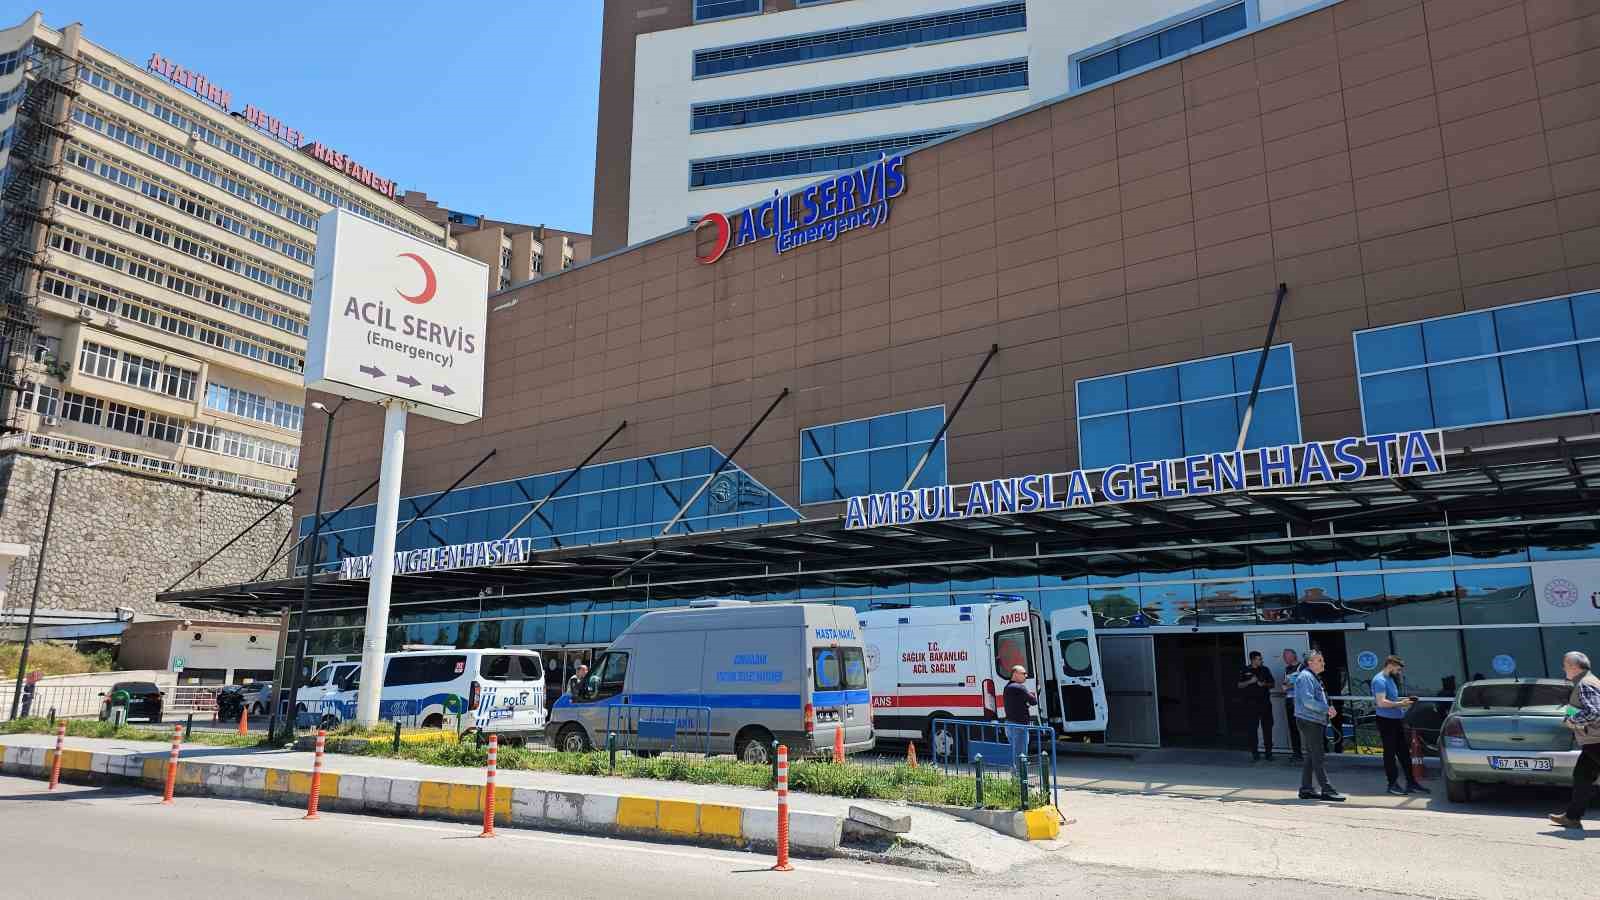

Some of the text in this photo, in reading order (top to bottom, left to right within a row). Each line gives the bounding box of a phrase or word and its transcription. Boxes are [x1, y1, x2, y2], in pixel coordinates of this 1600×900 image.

[738, 152, 905, 247] ACİL SERVİS
[776, 200, 889, 254] (Emergency)
[344, 296, 475, 353] ACİL SERVİS
[367, 330, 454, 368] (Emergency)
[845, 430, 1440, 530] AMBULANSLA GELEN HASTA
[1000, 612, 1027, 625] AMBU
[873, 696, 892, 706] ANS
